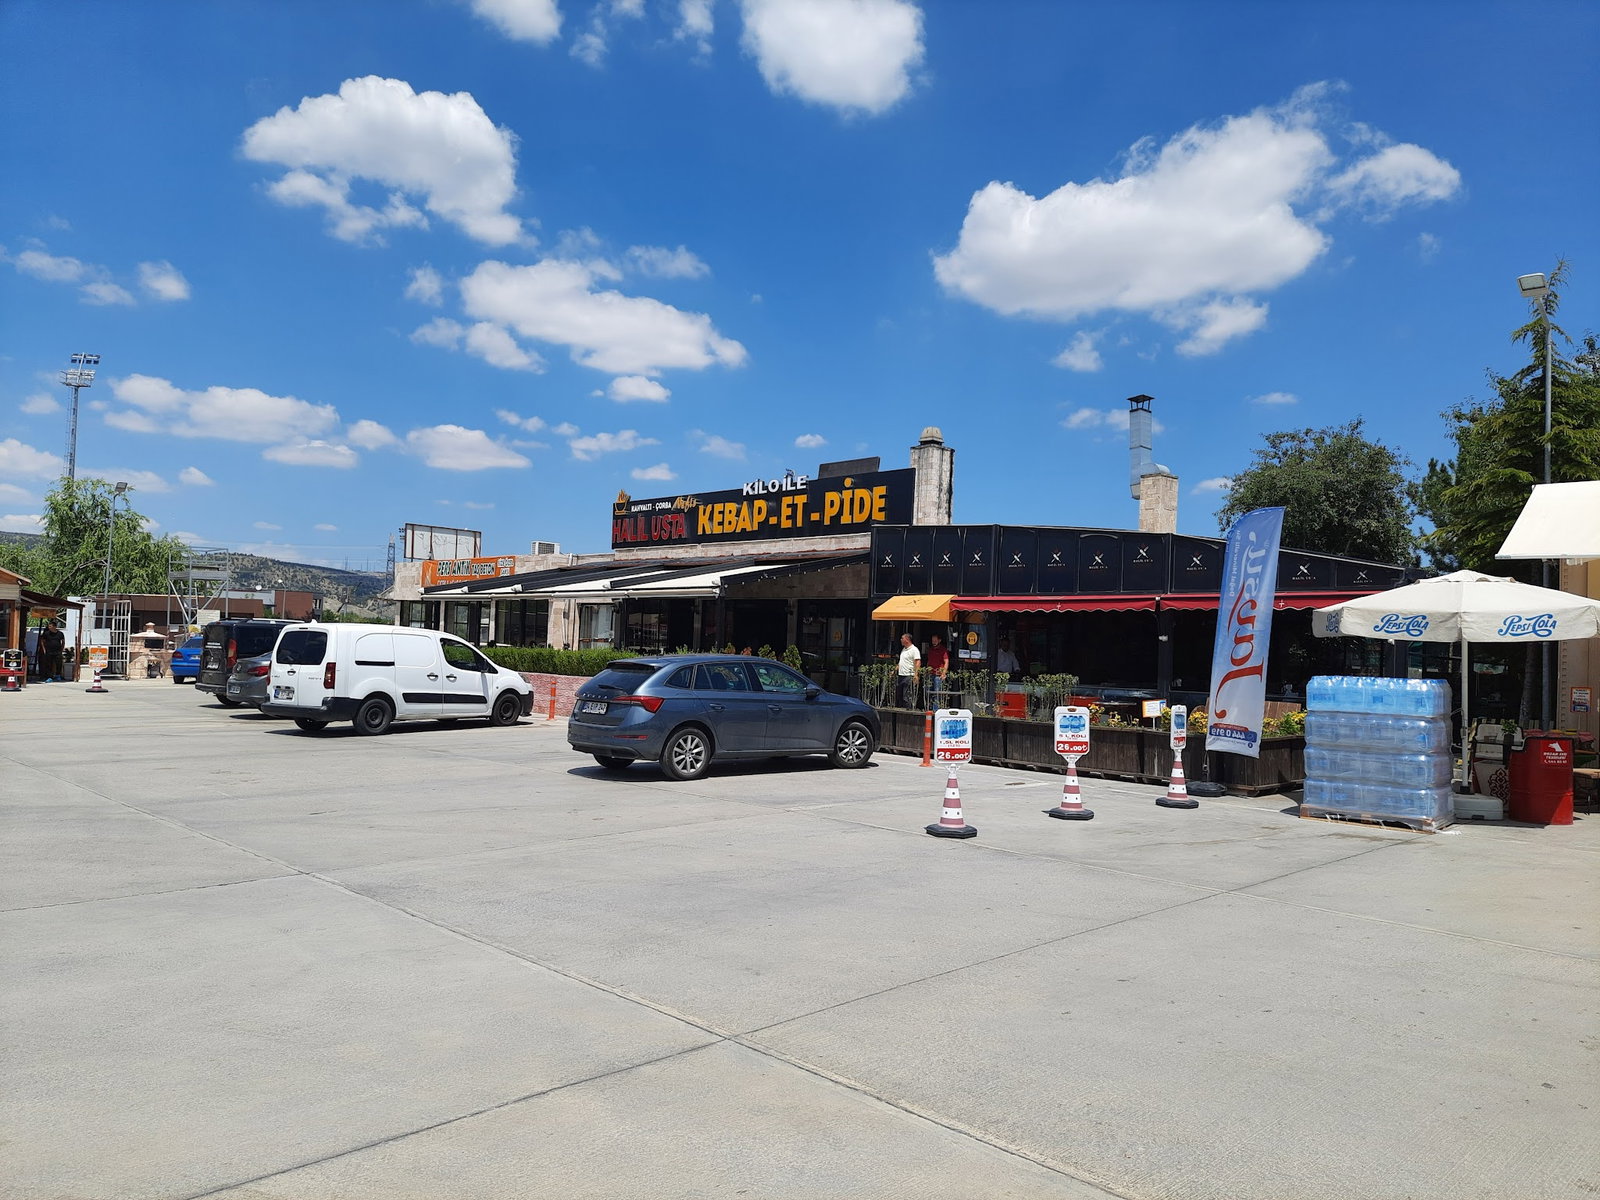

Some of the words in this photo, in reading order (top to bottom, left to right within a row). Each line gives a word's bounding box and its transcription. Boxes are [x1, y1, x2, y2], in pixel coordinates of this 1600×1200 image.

[631, 503, 652, 512] KAHVALTI
[656, 501, 672, 512] ÇORBA
[652, 513, 687, 541] USTA
